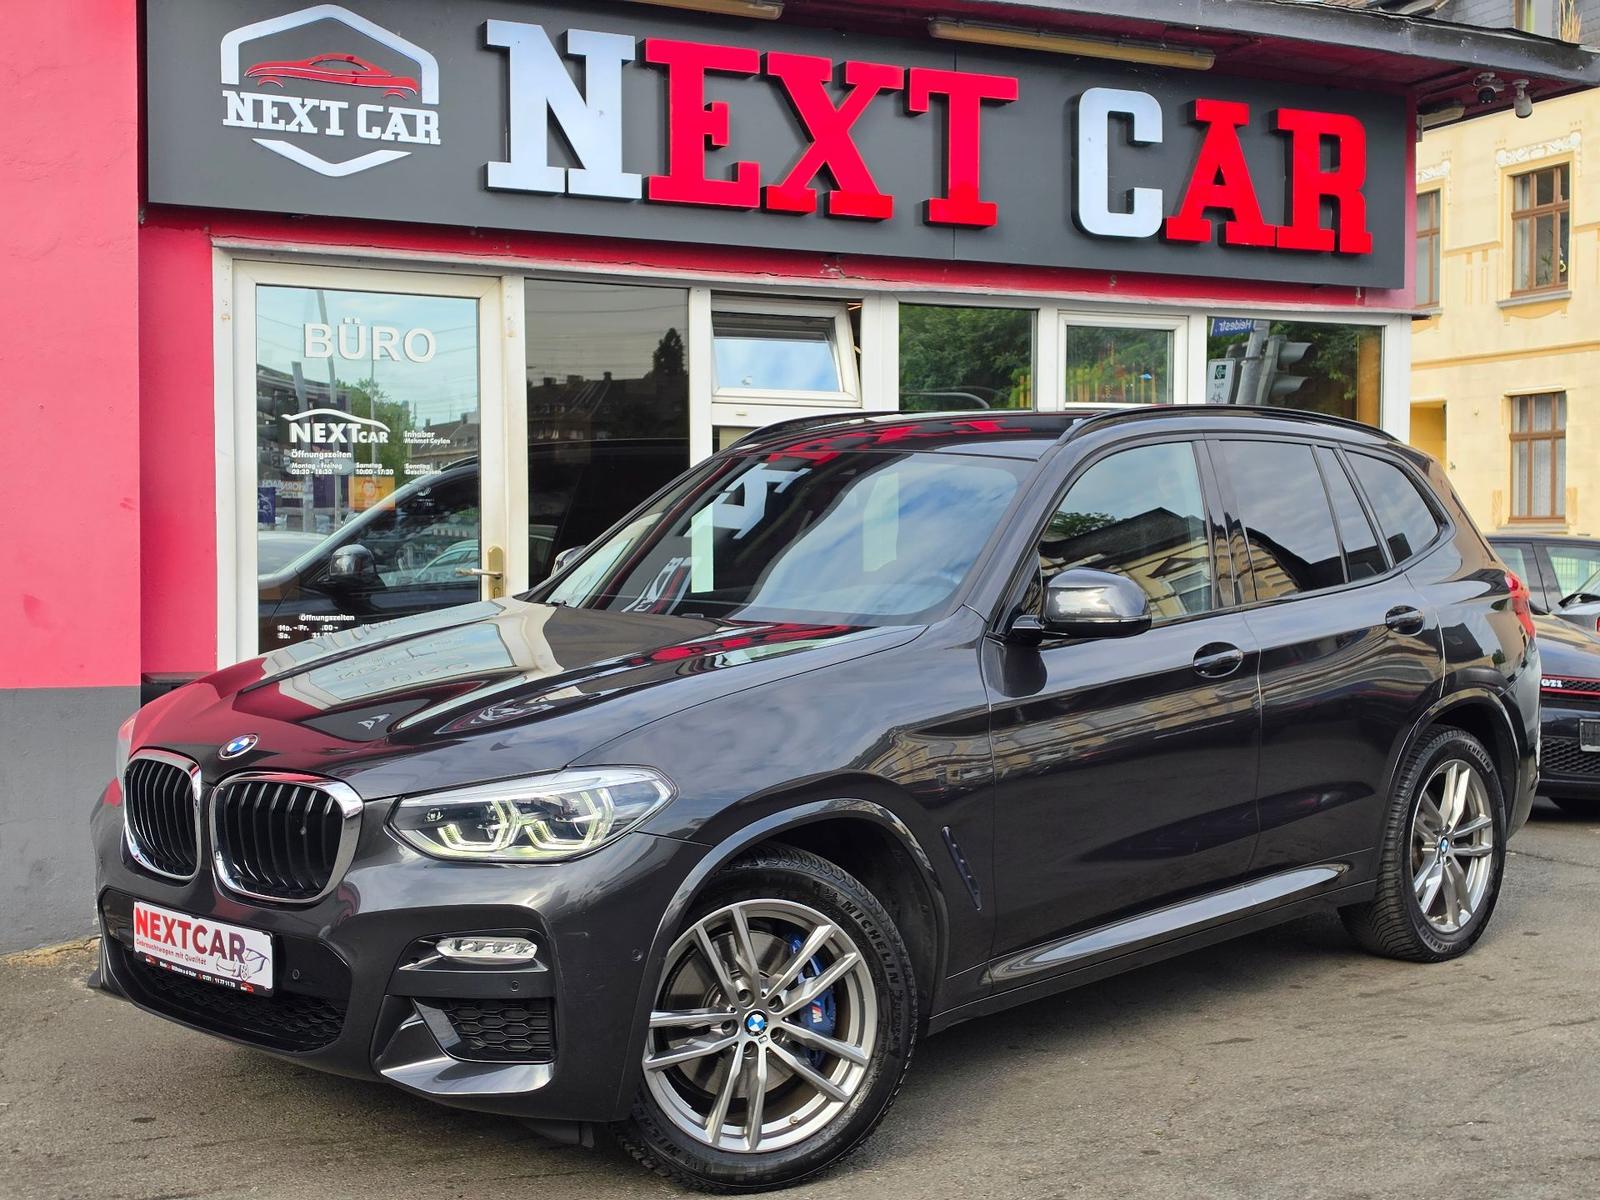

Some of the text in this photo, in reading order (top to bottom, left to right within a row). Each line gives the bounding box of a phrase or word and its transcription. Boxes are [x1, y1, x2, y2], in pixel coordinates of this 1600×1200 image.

[222, 90, 441, 145] NEXT CAR
[484, 19, 1373, 256] NEXT CAR
[304, 317, 436, 363] BÜRO
[291, 449, 352, 459] Öffnungszeiten
[299, 613, 355, 622] Öffnungszeiten
[1541, 678, 1563, 688] GTI
[135, 907, 246, 964] NEXTCAR
[842, 900, 900, 986] MICHELIN
